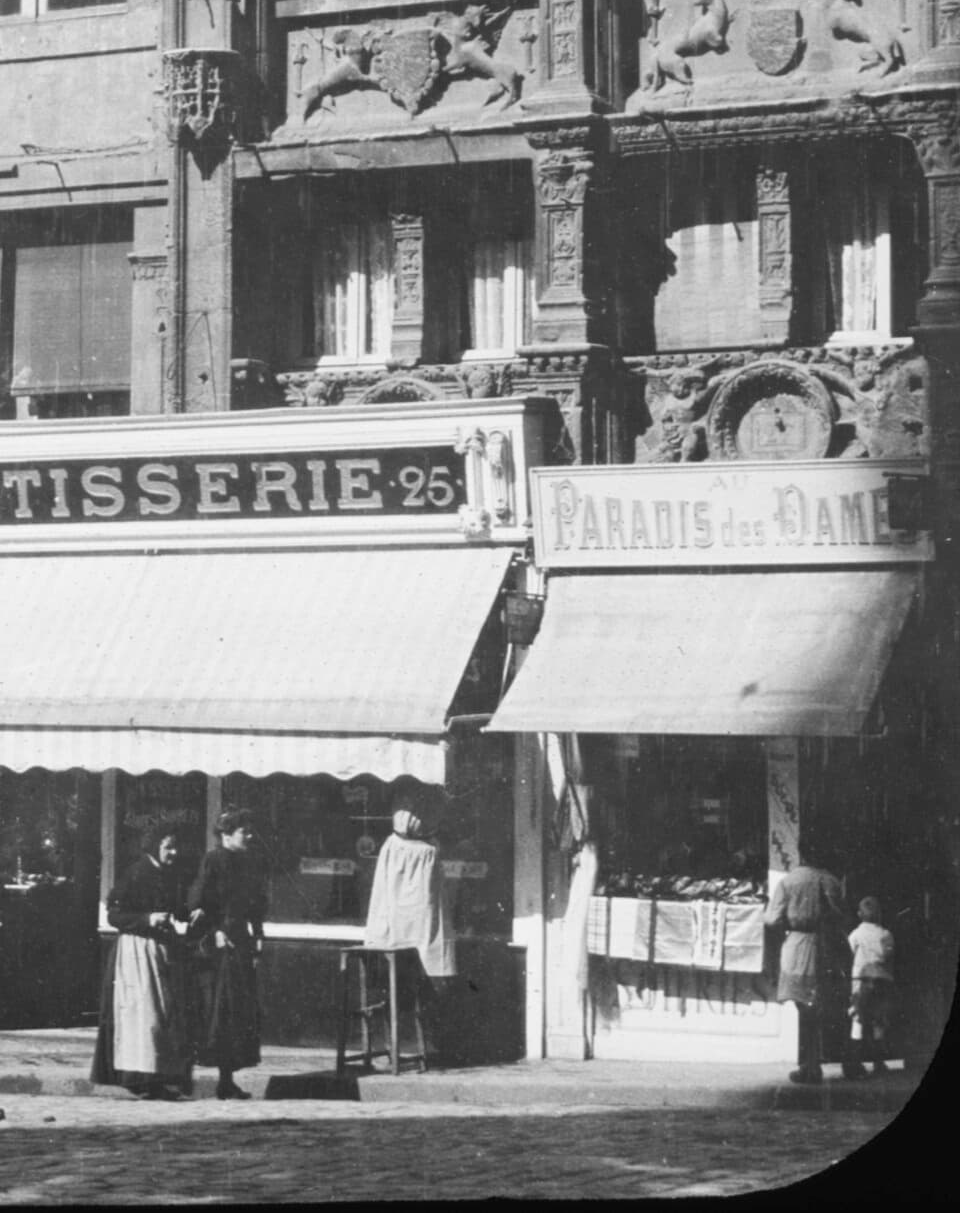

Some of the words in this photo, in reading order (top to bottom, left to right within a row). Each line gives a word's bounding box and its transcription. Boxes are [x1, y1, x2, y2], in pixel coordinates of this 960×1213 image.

[398, 466, 455, 507] 25
[550, 478, 715, 551] PARADIS
[773, 482, 917, 547] DAME
